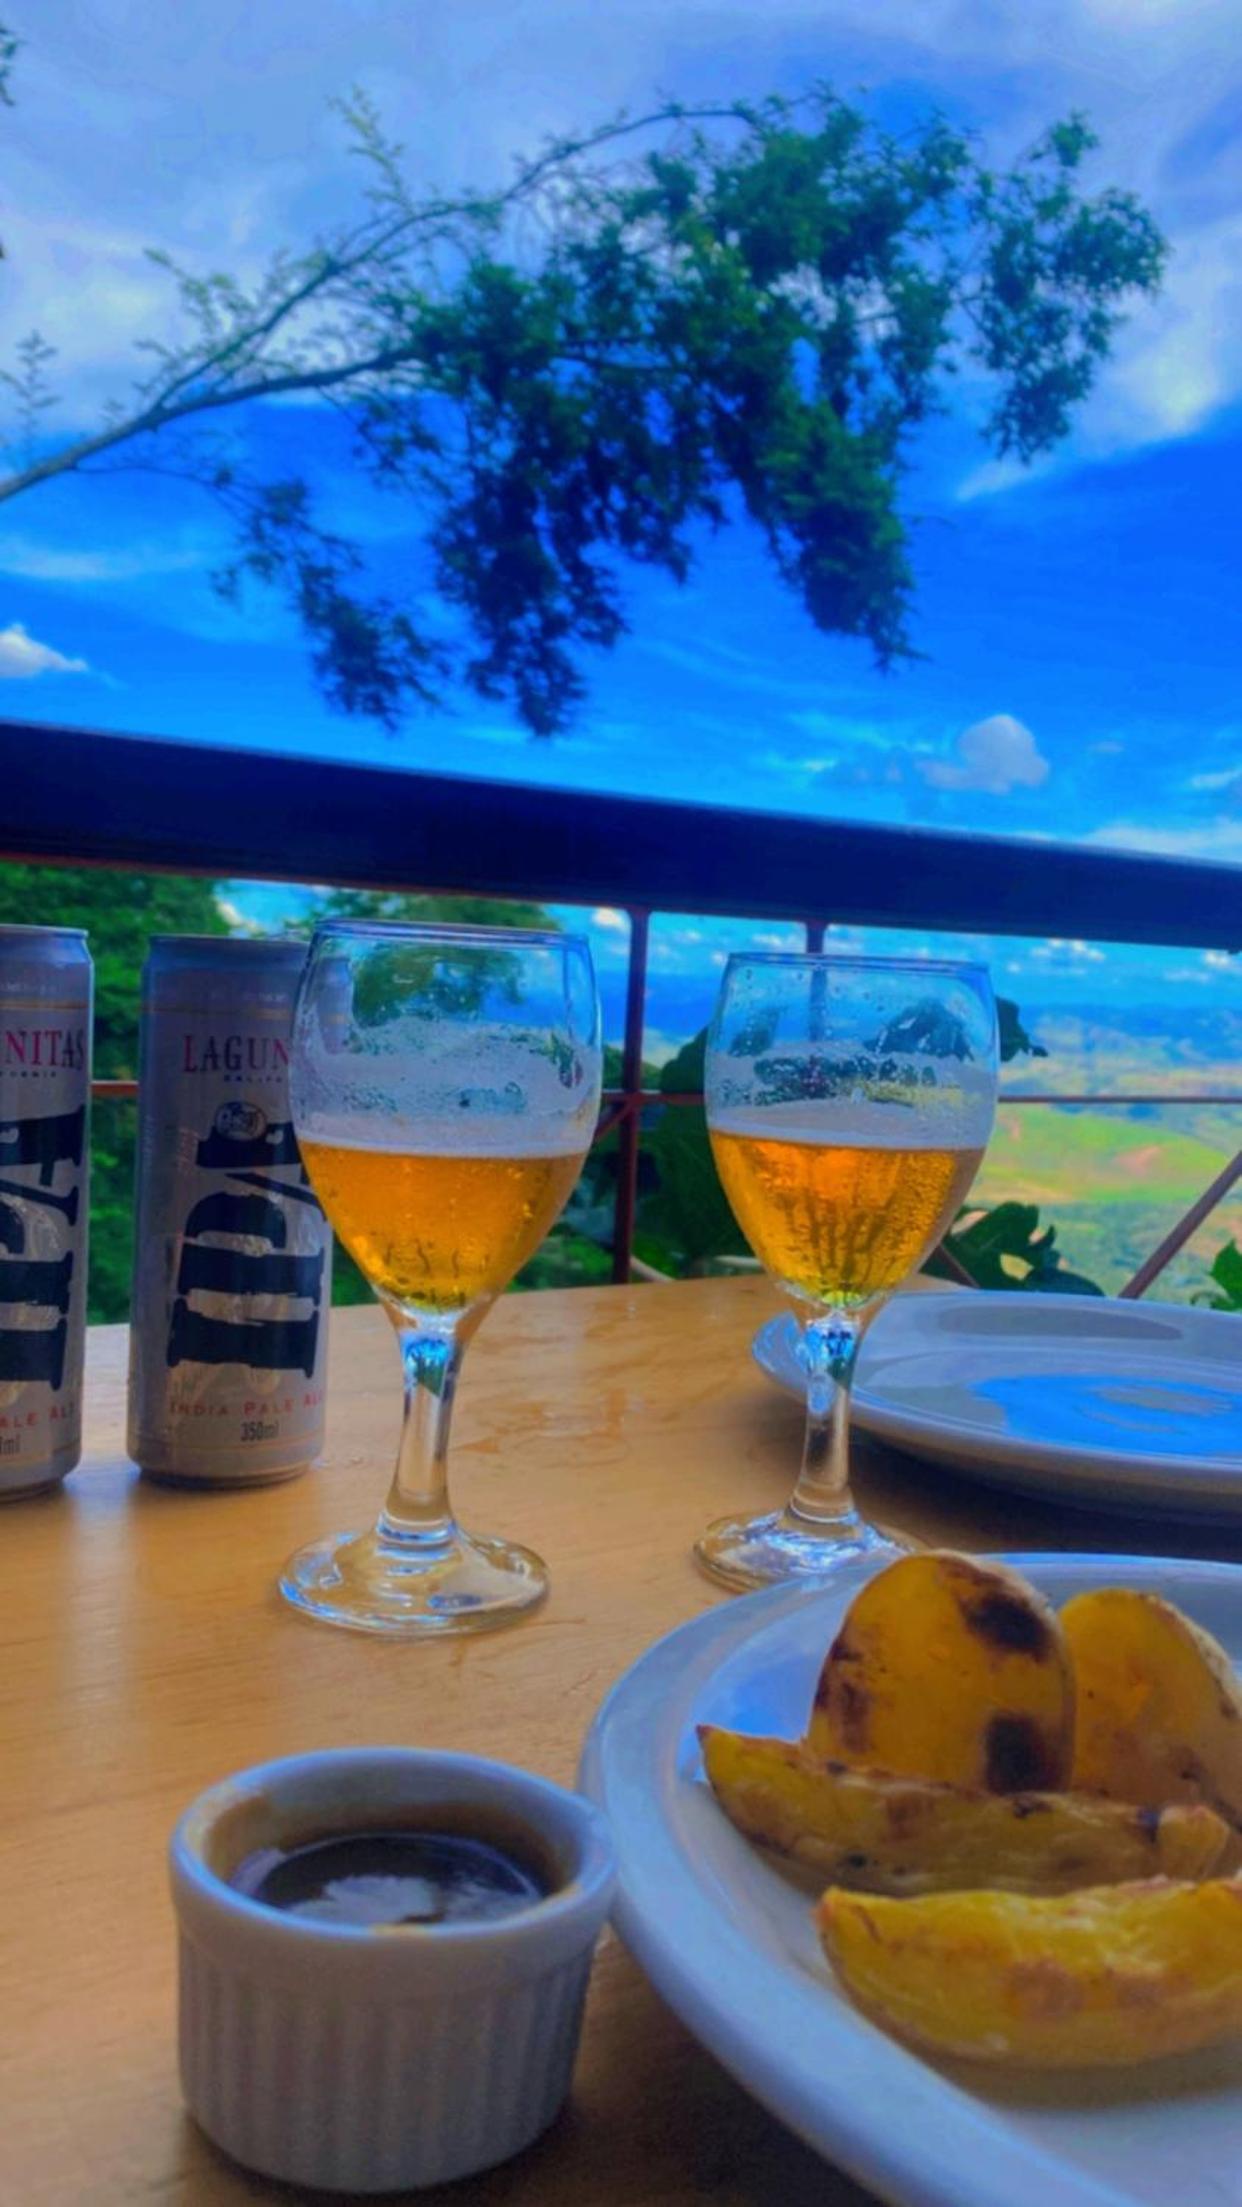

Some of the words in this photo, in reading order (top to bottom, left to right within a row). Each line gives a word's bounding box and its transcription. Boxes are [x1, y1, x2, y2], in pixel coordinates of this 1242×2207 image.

[5, 1028, 84, 1071] NITAS
[183, 1034, 289, 1072] LAGUN
[169, 1400, 229, 1416] INDIA
[243, 1398, 294, 1416] PALE
[240, 1421, 279, 1442] 350ml
